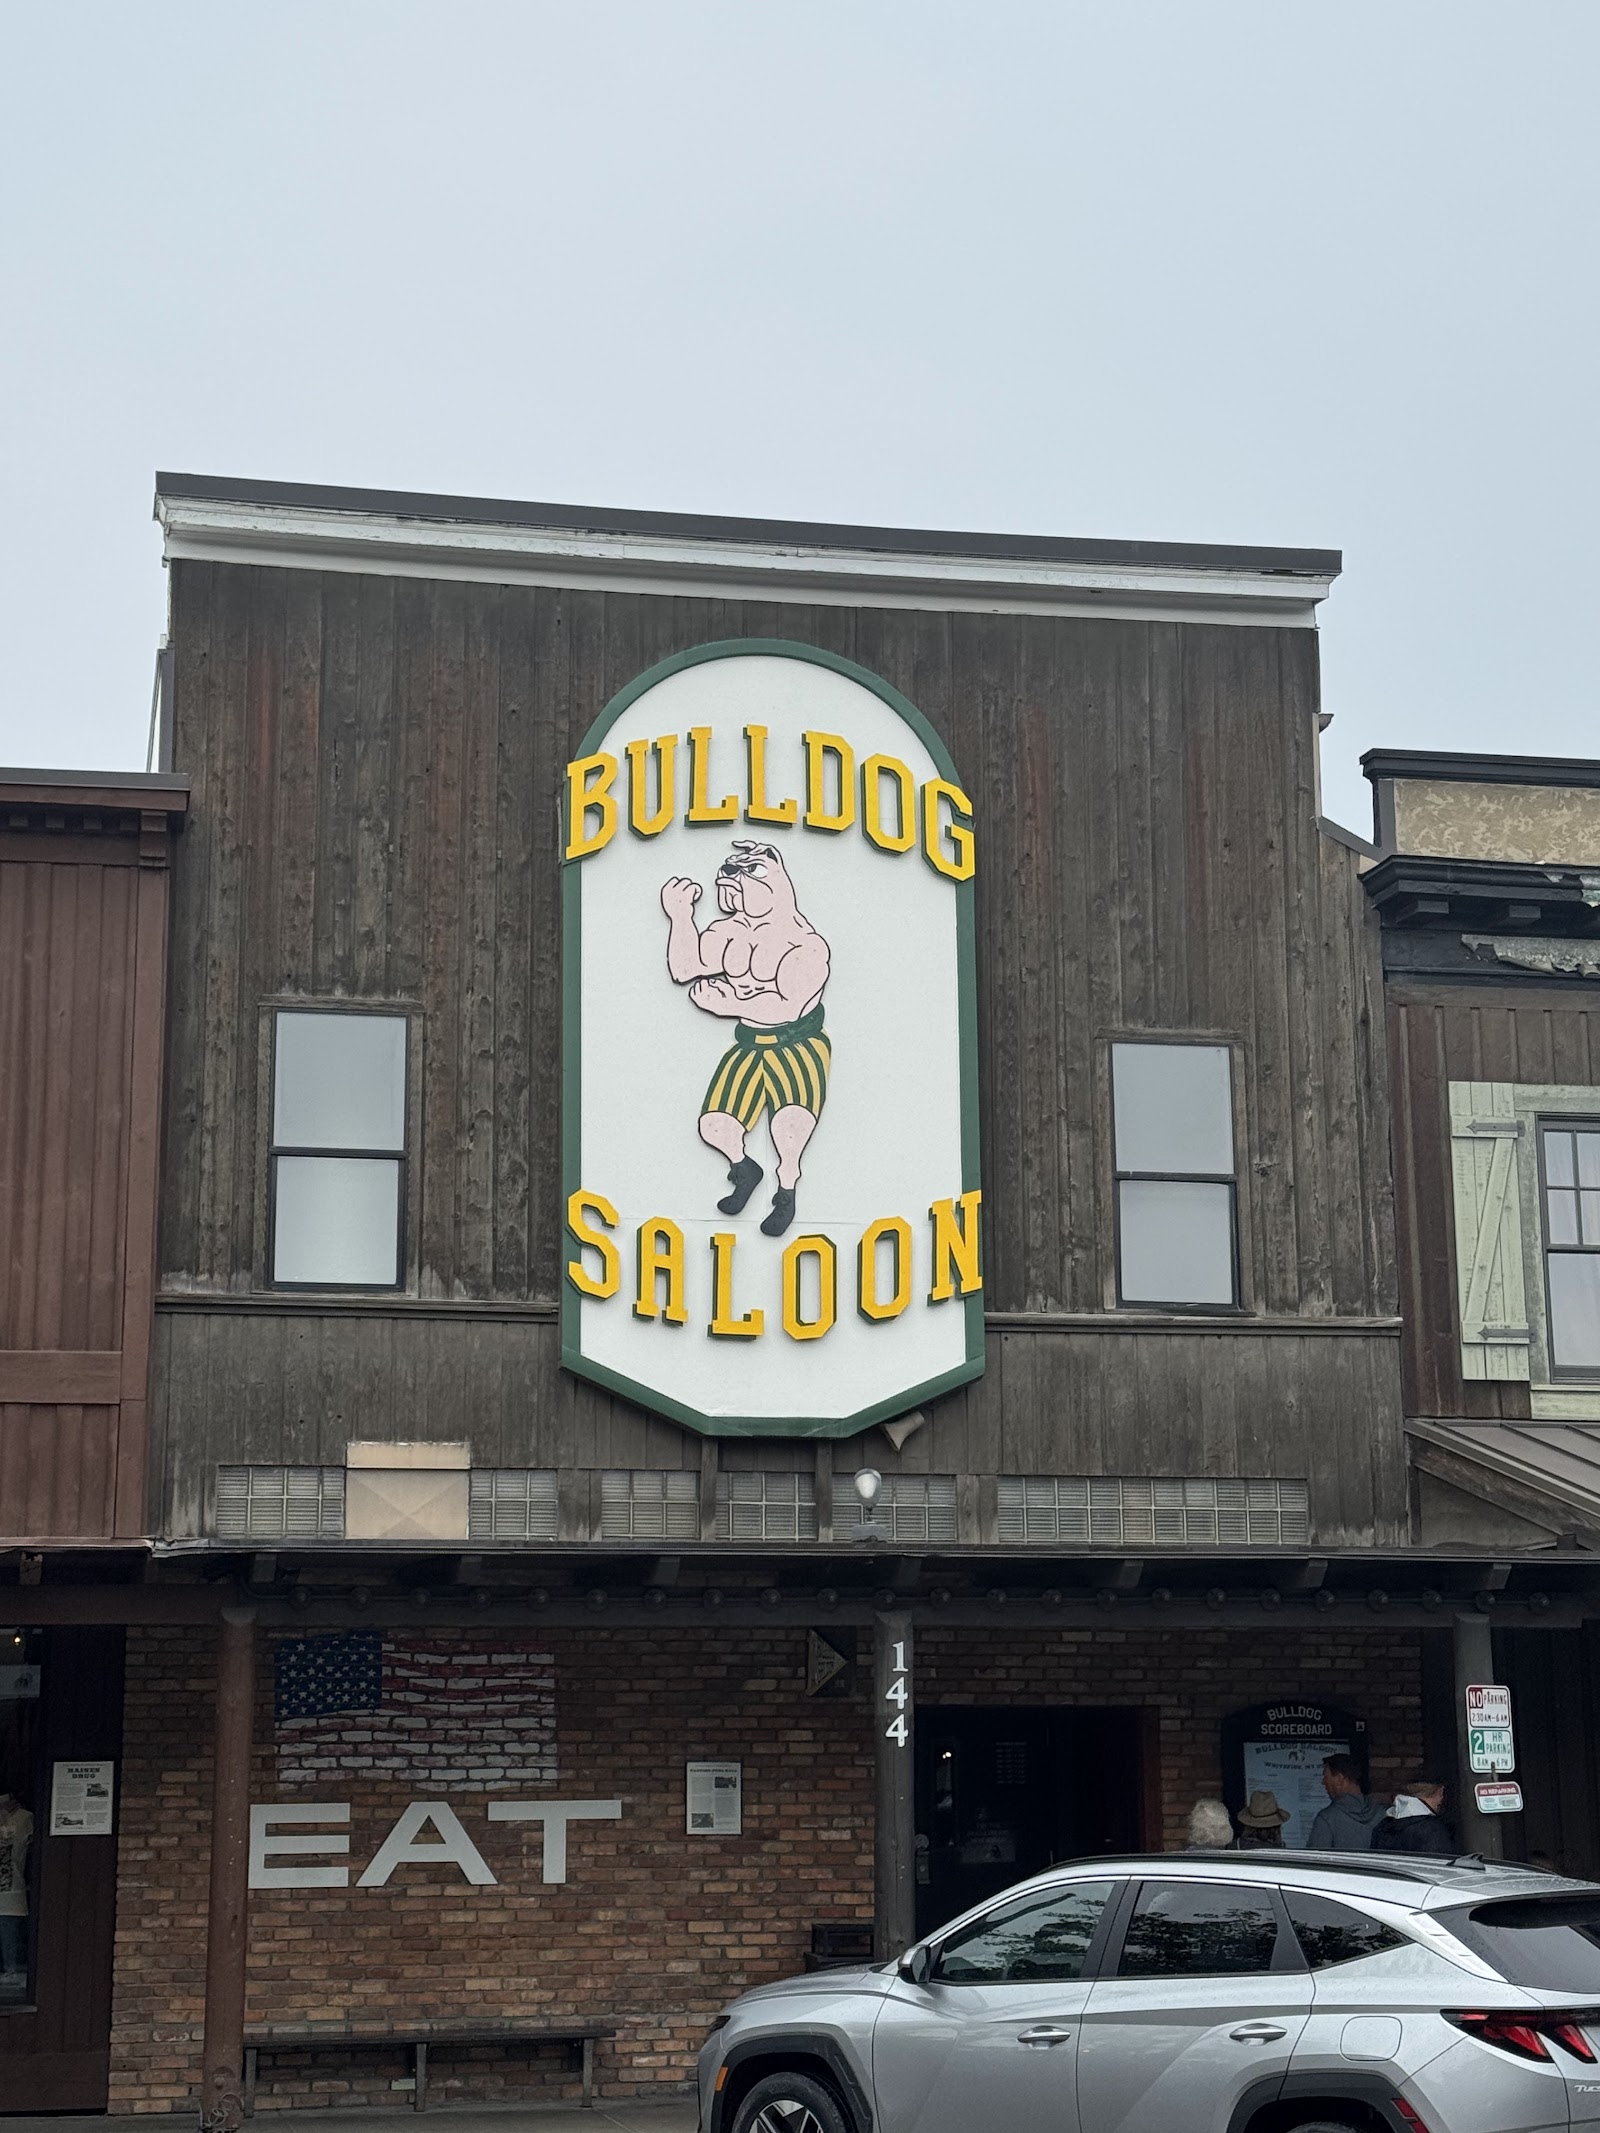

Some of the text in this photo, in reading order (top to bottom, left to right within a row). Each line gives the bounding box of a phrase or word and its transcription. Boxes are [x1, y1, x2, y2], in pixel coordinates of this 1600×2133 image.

[564, 725, 975, 882] BULLDOG
[566, 1188, 983, 1342] SALOON
[885, 1641, 909, 1748] 144
[1469, 1690, 1507, 1708] NO PARKING
[1267, 1706, 1322, 1720] BULLDOG
[1261, 1724, 1332, 1735] SCOREBOARD
[1255, 1743, 1338, 1754] BULLDOG SALOON
[1473, 1731, 1503, 1753] 2 HR
[1486, 1743, 1511, 1755] PARKING
[248, 1799, 623, 1889] EAT
